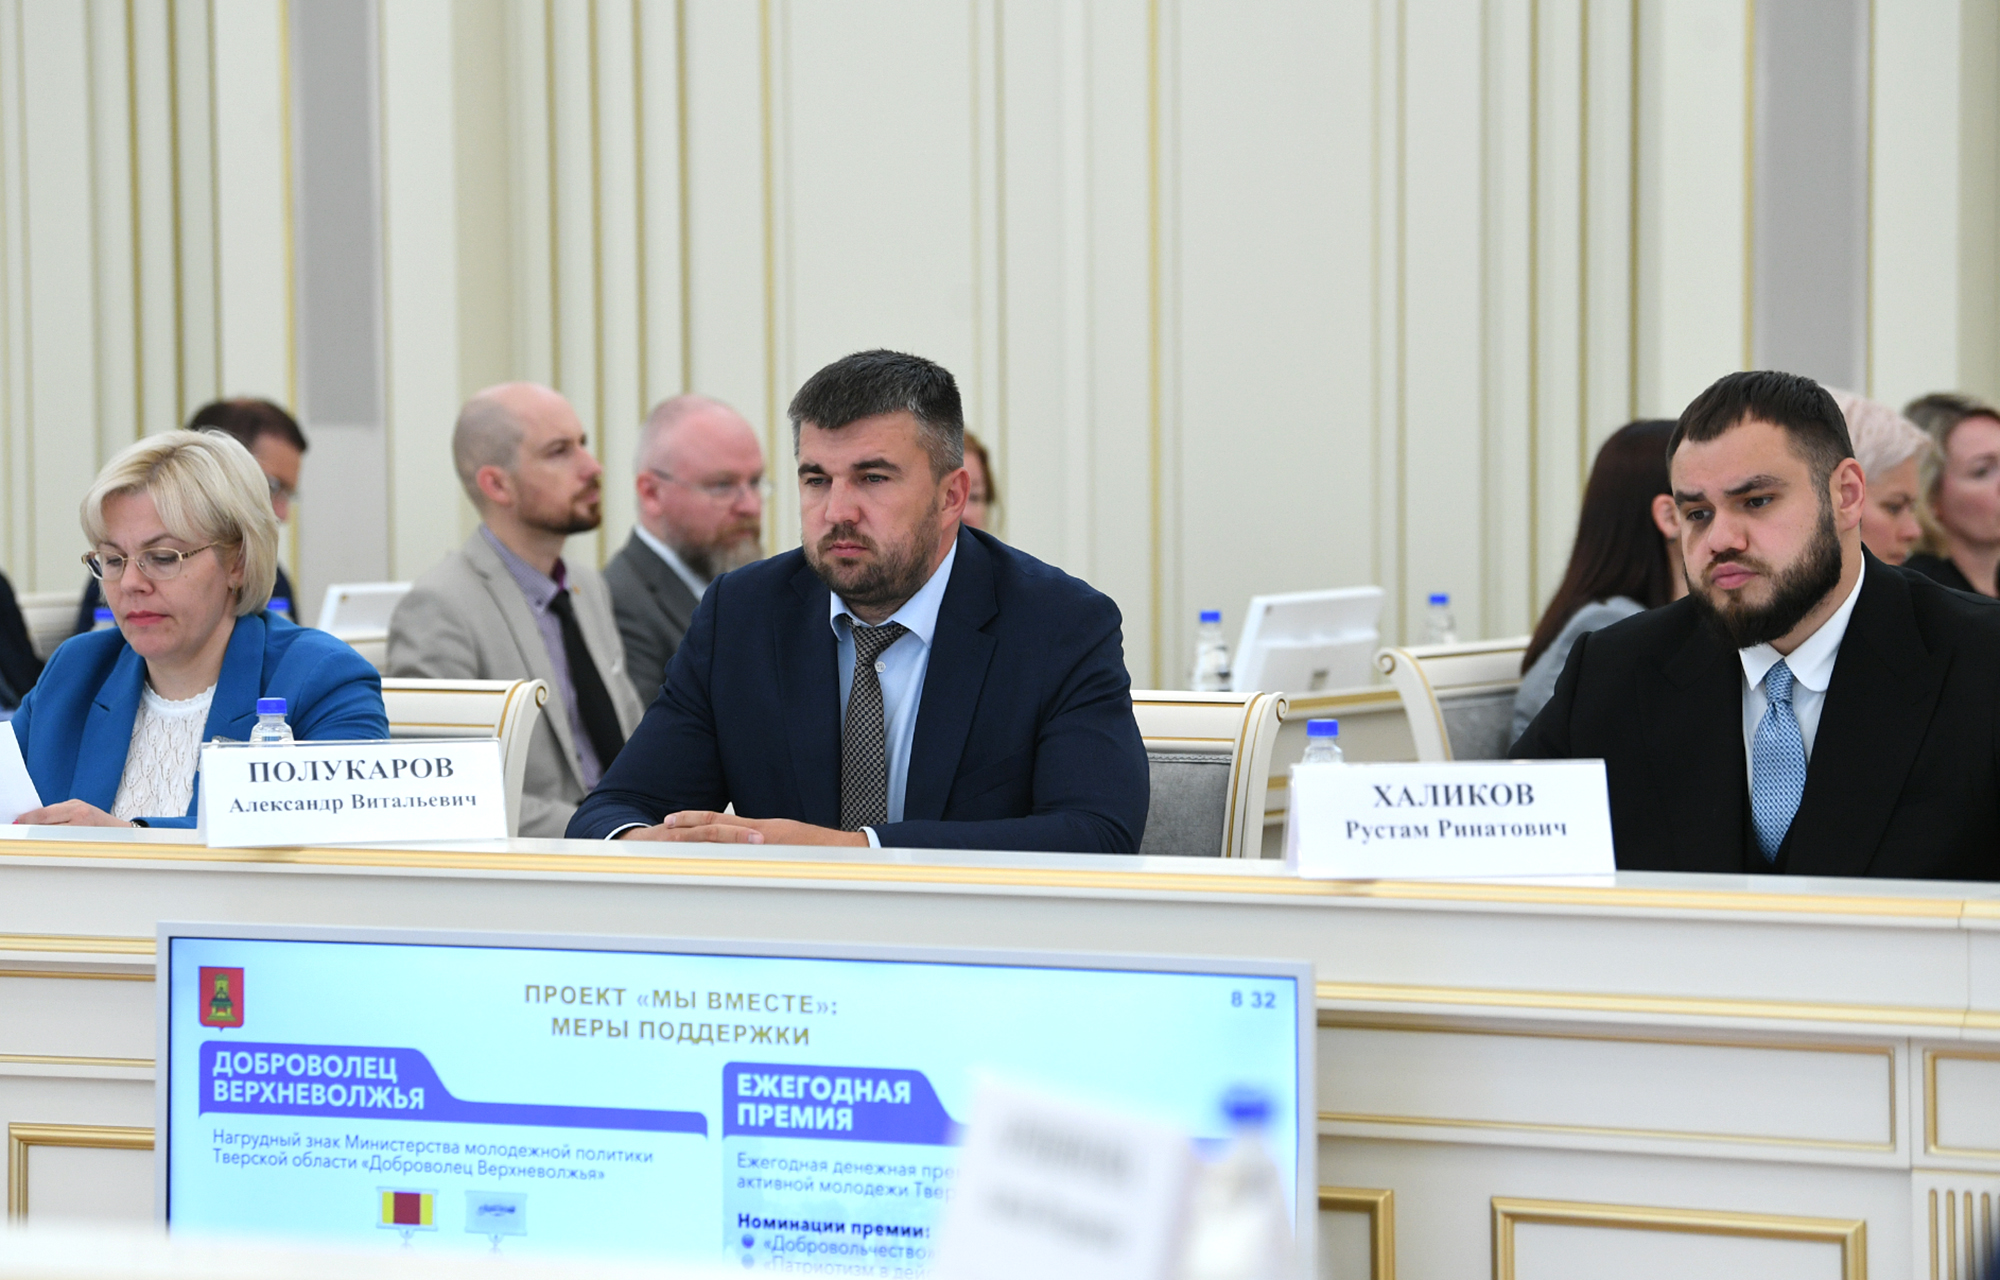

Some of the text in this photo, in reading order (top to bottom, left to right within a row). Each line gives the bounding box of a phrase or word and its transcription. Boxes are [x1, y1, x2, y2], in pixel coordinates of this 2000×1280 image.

[248, 757, 454, 783] ПОЛУКАРОВ
[229, 793, 477, 814] Александр Витальевич
[1373, 783, 1535, 808] ХАЛИКОВ
[1346, 819, 1567, 844] Рустам Ринатович
[525, 984, 837, 1015] ПРОЕКТ «МЫ ВМЕСТЕ»:
[1231, 990, 1276, 1009] 8 32
[551, 1017, 809, 1046] МЕРЫ ПОДДЕРЖКИ
[212, 1051, 398, 1083] ДОБРОВОЛЕЦ
[212, 1079, 425, 1110] ВЕРХНЕВОЛЖЬЯ
[737, 1073, 911, 1105] ЕЖЕГОДНАЯ
[737, 1103, 853, 1132] ПРЕМИЯ
[213, 1128, 654, 1163] Нагрудный знак Министерства молодежной политики
[213, 1148, 605, 1181] Тверской области «Доброволец Верхневолжья»
[737, 1152, 960, 1180] Ежегодная денежная пре
[737, 1175, 814, 1192] активной
[819, 1181, 909, 1198] молодежи
[737, 1213, 931, 1239] Номинации премии:
